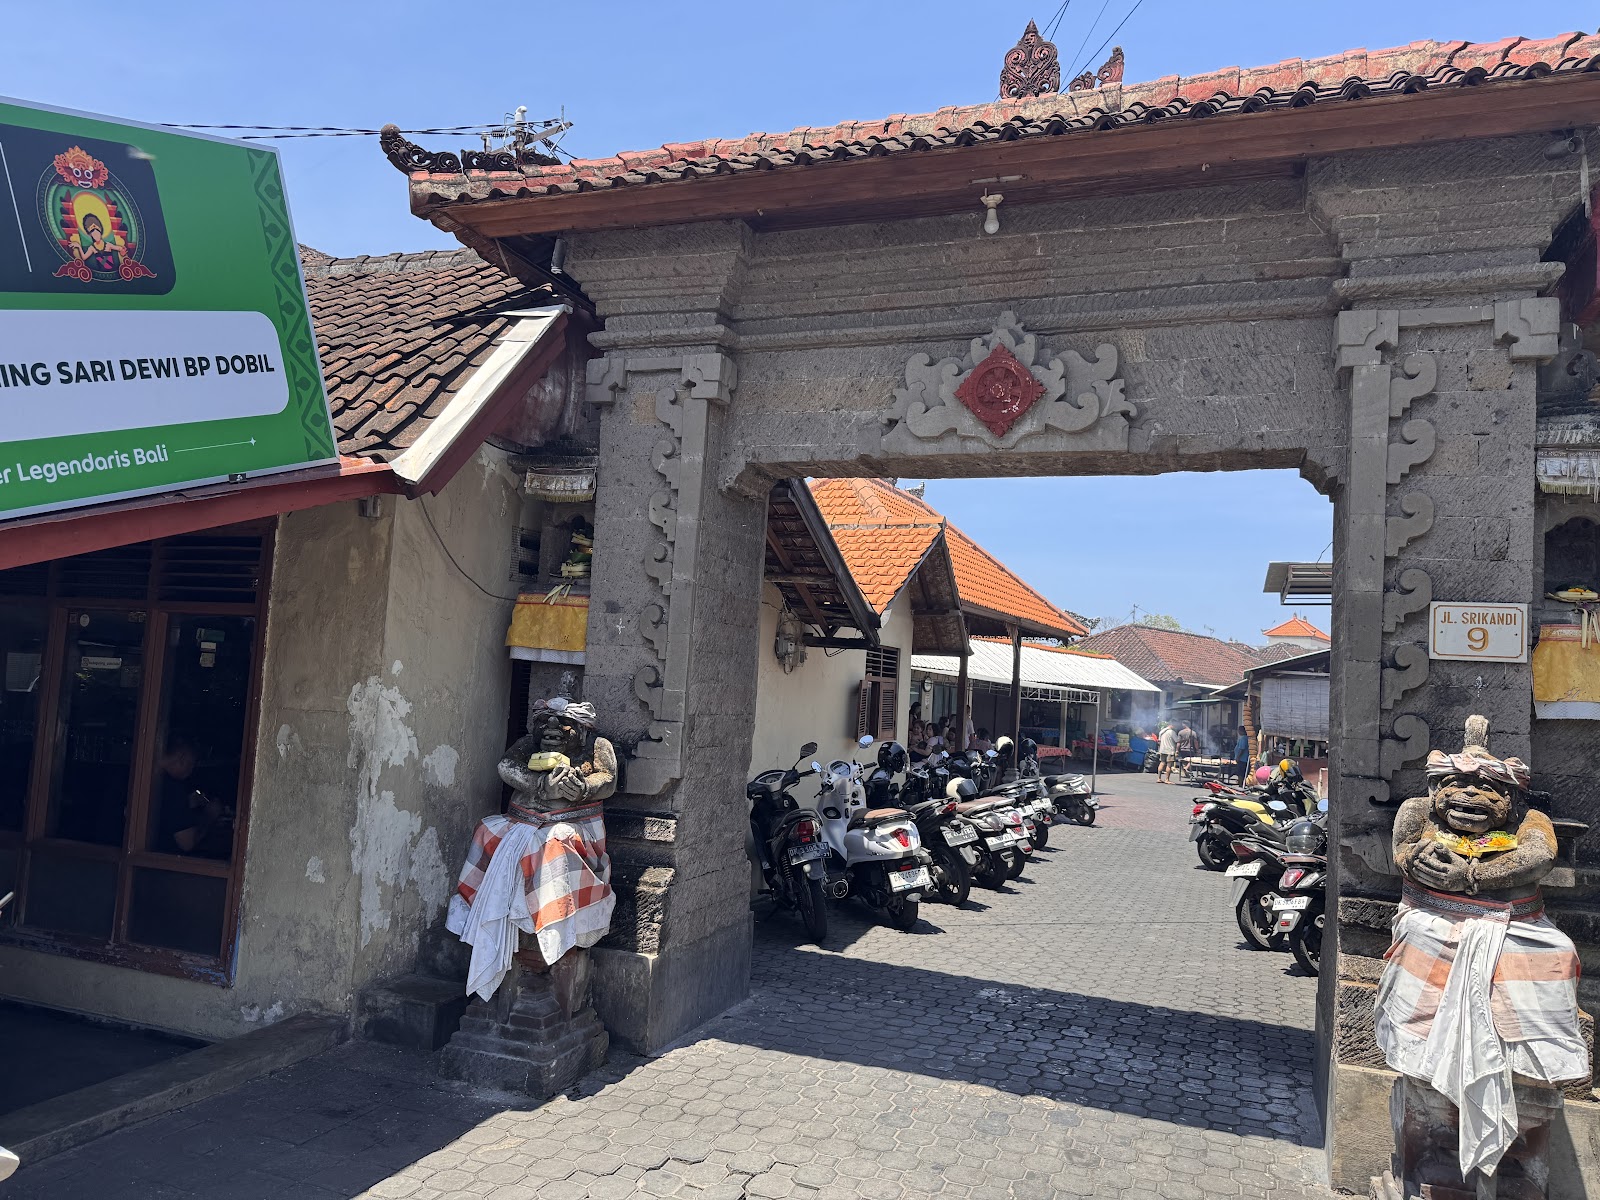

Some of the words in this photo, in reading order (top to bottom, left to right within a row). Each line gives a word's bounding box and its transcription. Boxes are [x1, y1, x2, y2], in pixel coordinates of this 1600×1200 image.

[0, 362, 51, 388] ING
[56, 360, 115, 385] SARI
[119, 357, 180, 381] DEWI
[183, 356, 211, 377] BP
[215, 354, 275, 375] DOBIL
[16, 450, 131, 483] Legendaris
[133, 443, 169, 466] Bali
[1440, 611, 1457, 624] JL.
[1461, 612, 1517, 626] SRIKANDI
[1467, 627, 1489, 652] 9
